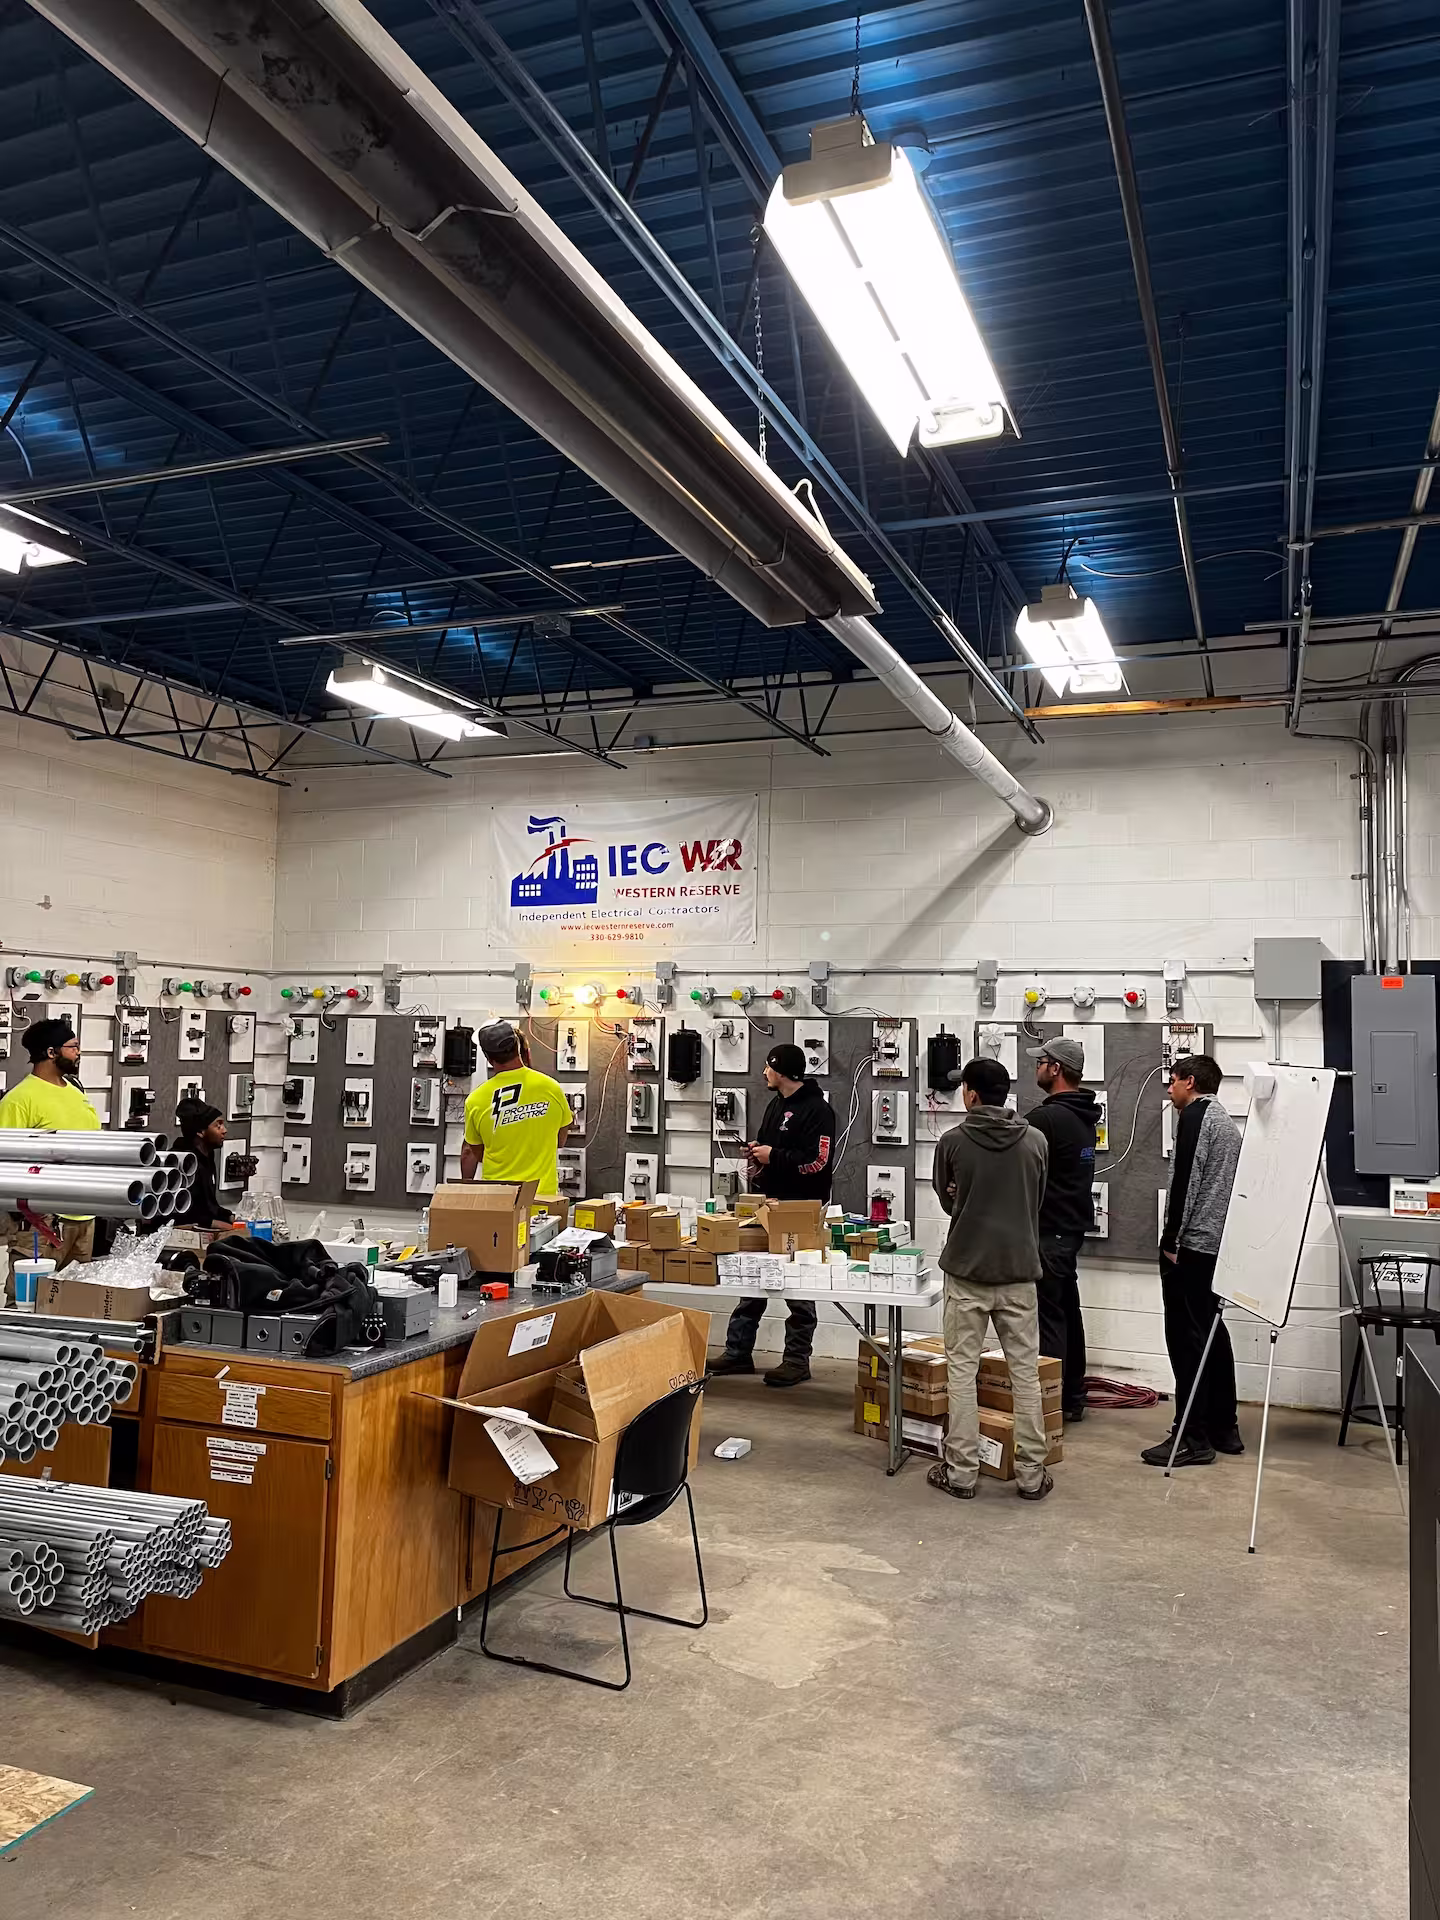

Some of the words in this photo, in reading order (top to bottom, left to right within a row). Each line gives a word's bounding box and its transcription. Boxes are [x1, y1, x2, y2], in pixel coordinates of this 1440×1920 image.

[608, 842, 670, 877] IEC
[613, 886, 676, 898] WESTERN
[680, 884, 740, 897] RESERVE
[519, 911, 587, 923] Independent
[591, 908, 643, 919] Electrical
[648, 905, 720, 916] Contractors
[560, 921, 674, 931] www.iecwesternreserve.com
[590, 933, 644, 941] 330-629-9810
[503, 1101, 550, 1117] PROTECH
[502, 1109, 548, 1125] ELECTRIC
[1385, 1270, 1423, 1278] PRTECH
